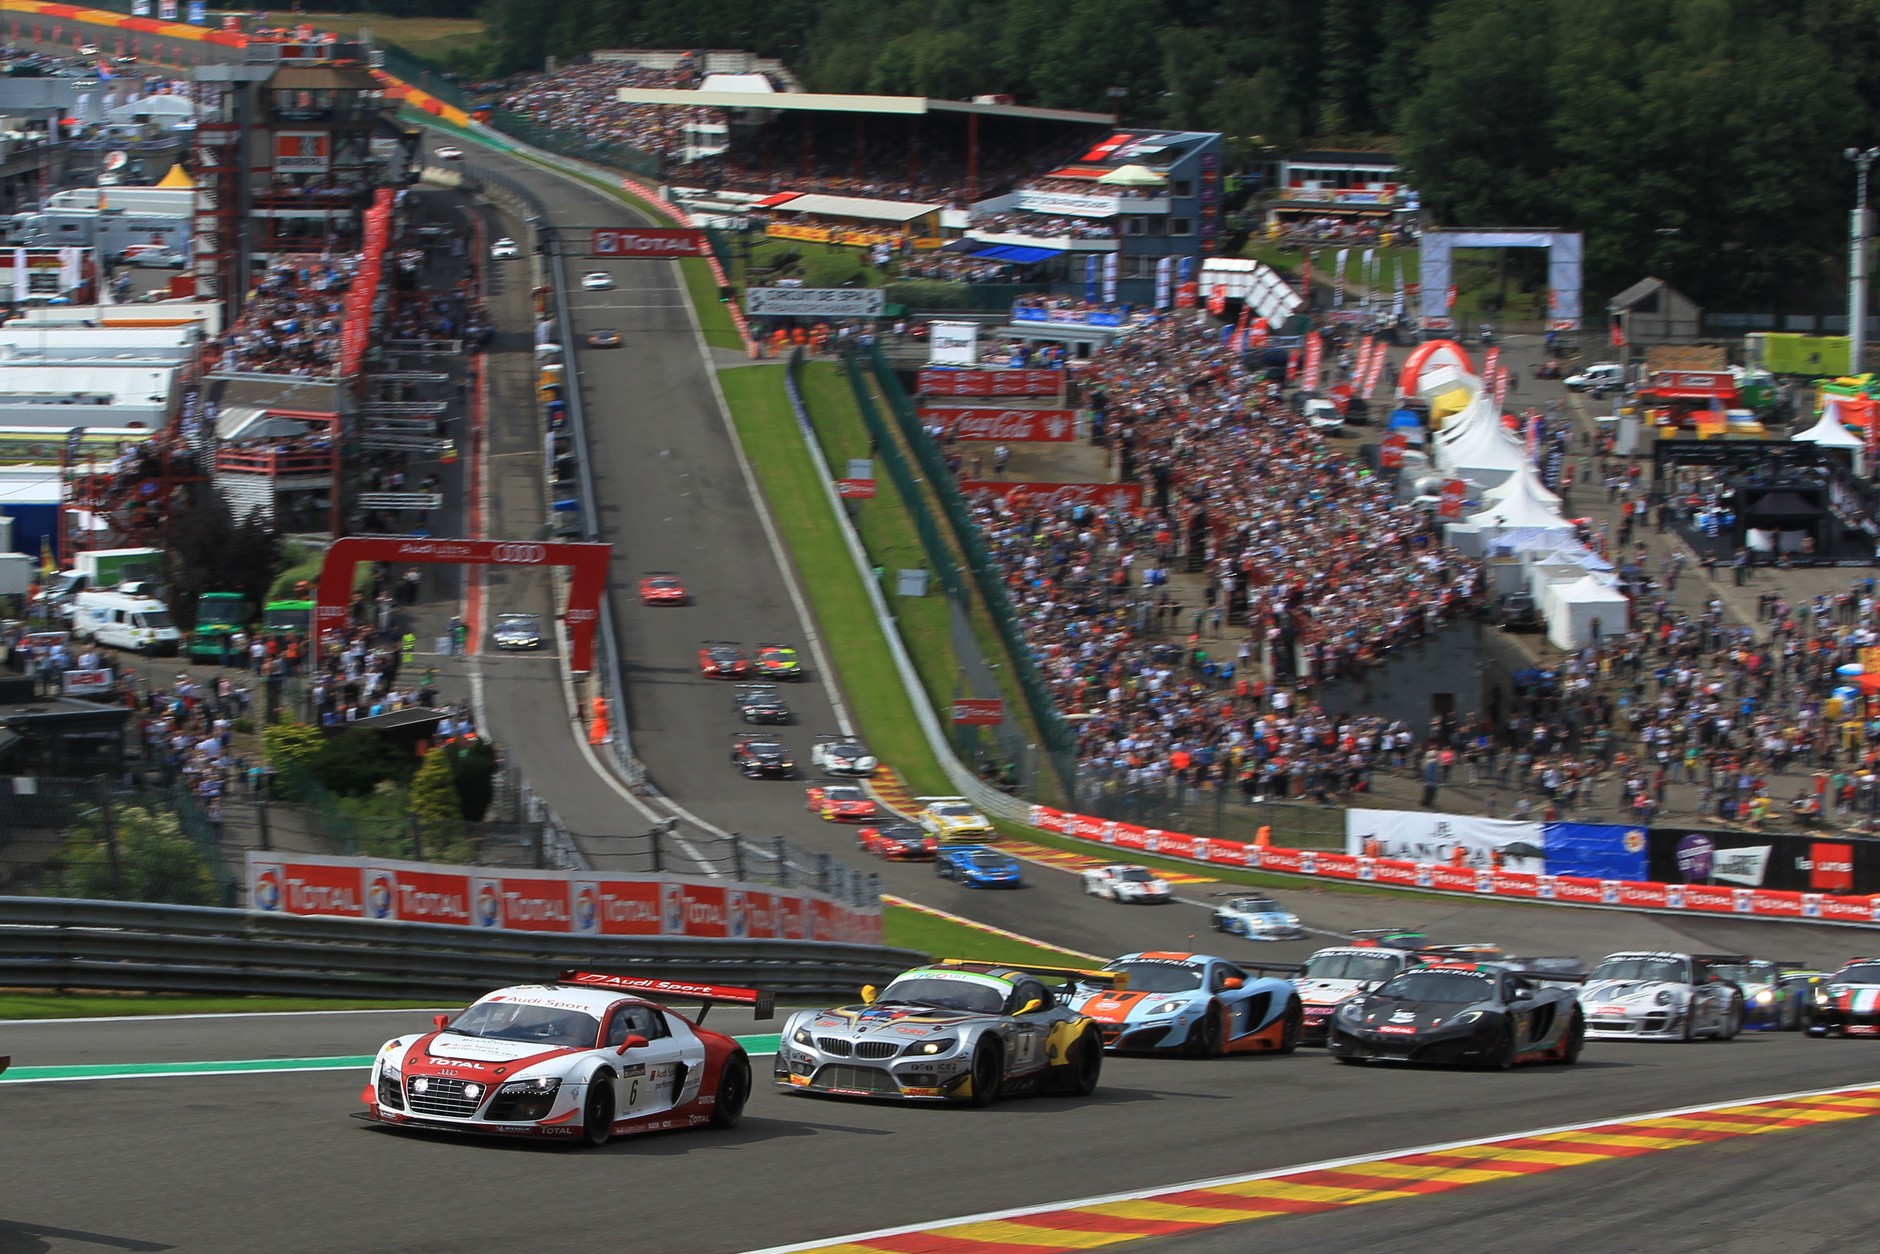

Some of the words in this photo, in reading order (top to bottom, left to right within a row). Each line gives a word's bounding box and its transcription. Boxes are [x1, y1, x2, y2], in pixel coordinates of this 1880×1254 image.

[619, 234, 697, 251] TOTAL
[286, 878, 364, 912] TOTAL
[398, 884, 470, 918] TOTAL
[503, 891, 571, 922] TOTAL
[599, 893, 662, 922] TOTAL
[1120, 957, 1199, 968] BLANCPAIN
[1407, 968, 1487, 978] BLANCPAIN
[605, 976, 651, 988] Audi
[655, 981, 713, 993] Sport
[508, 995, 541, 1005] Audi
[545, 999, 591, 1012] Sport
[1378, 1025, 1414, 1035] TOTAL
[428, 1057, 485, 1070] TOTAL
[629, 1079, 639, 1106] 6
[689, 1114, 710, 1124] TOTAL
[540, 1127, 572, 1135] TOTAL
